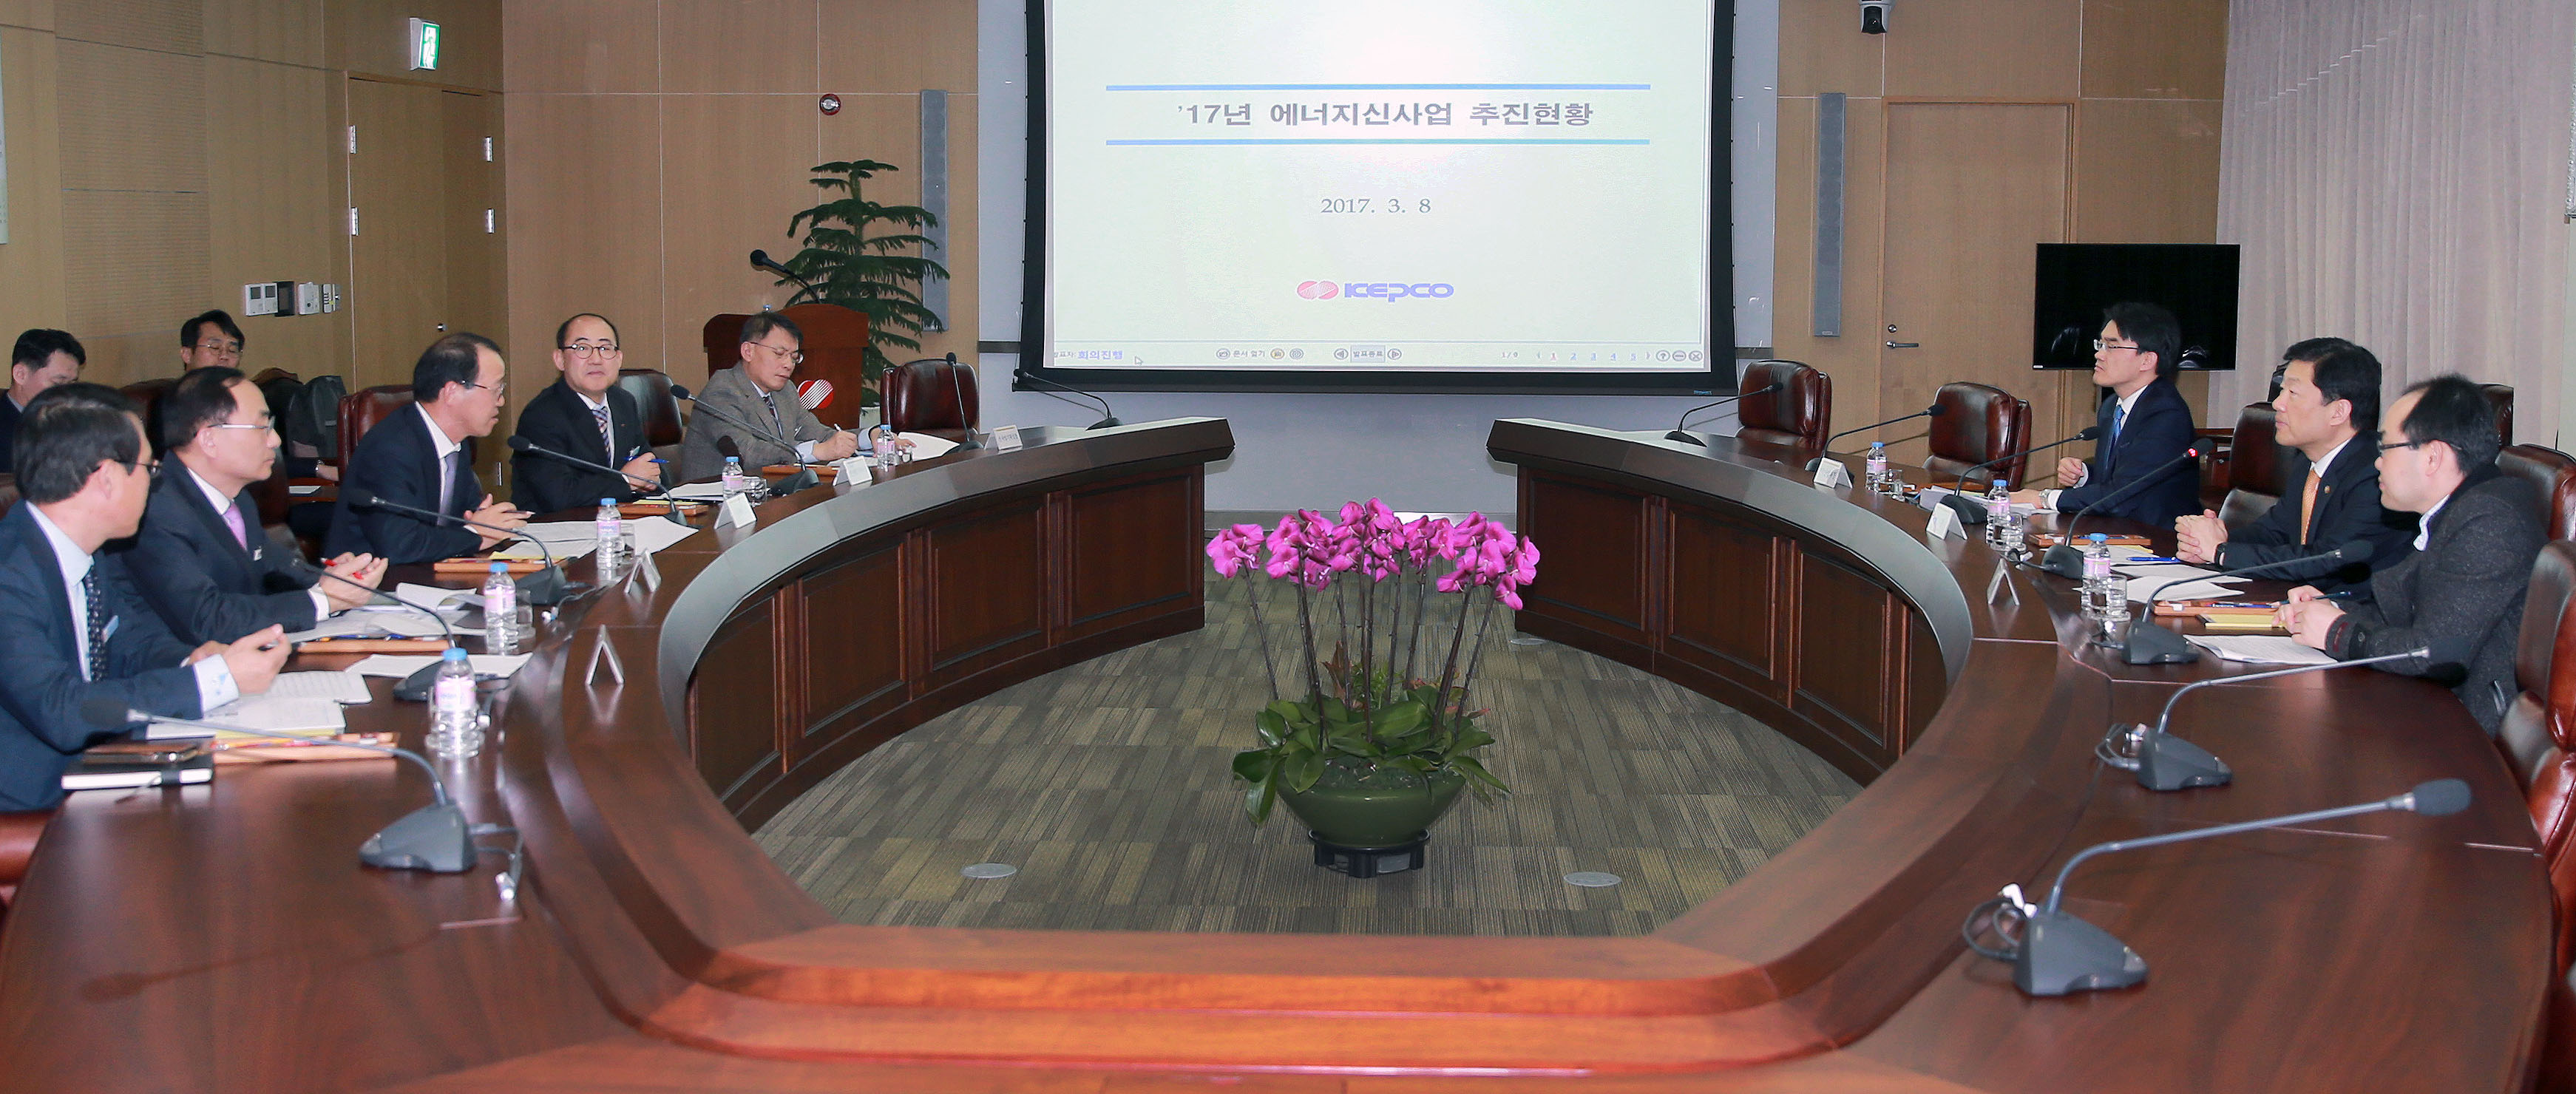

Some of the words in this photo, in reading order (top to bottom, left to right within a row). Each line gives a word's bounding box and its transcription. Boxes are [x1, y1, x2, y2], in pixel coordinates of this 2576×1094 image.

[1270, 103, 1452, 126] 에너지신사업
[1470, 103, 1593, 126] 추진현황
[1321, 198, 1375, 214] 2017.
[1388, 198, 1406, 214] 3.
[1419, 198, 1431, 214] 8
[1344, 282, 1454, 302] KEPCO
[1077, 350, 1123, 361] 회의진행
